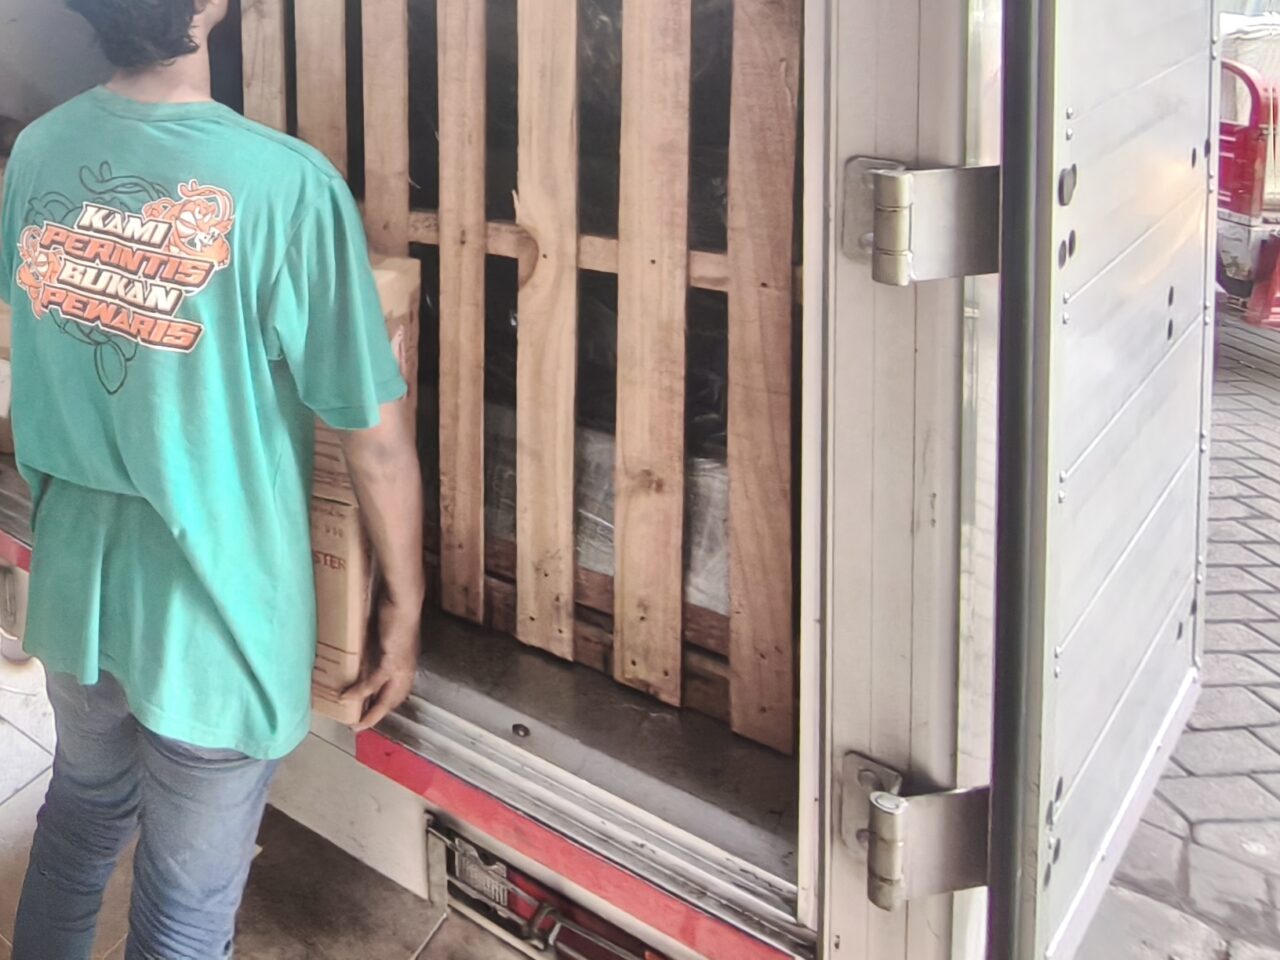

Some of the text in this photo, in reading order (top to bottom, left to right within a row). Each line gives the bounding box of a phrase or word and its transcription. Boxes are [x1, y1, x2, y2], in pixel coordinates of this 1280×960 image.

[78, 205, 171, 246] KAMI
[40, 224, 214, 288] PERINTIS
[58, 260, 181, 315] BUKAN
[42, 286, 202, 349] PEWARIS
